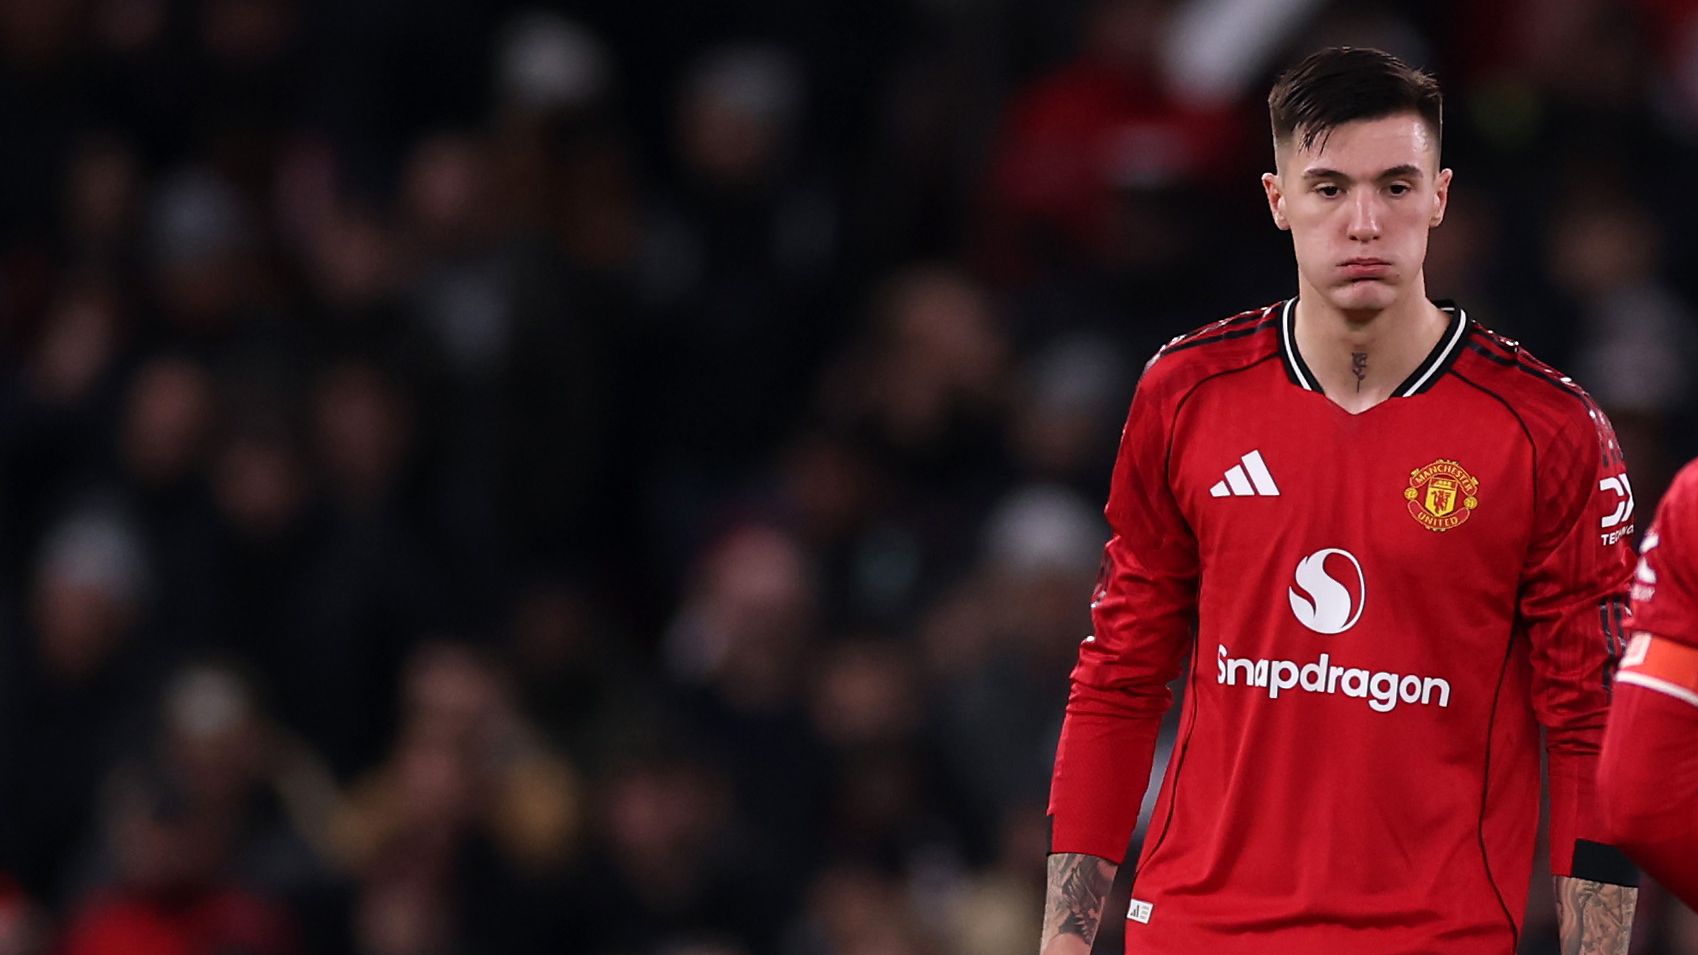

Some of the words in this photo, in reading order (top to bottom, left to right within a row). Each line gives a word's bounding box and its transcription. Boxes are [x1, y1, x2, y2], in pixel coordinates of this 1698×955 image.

[1415, 464, 1473, 491] MANCHESTER
[1418, 511, 1458, 527] UNITED
[1217, 643, 1450, 713] Snapdragon
